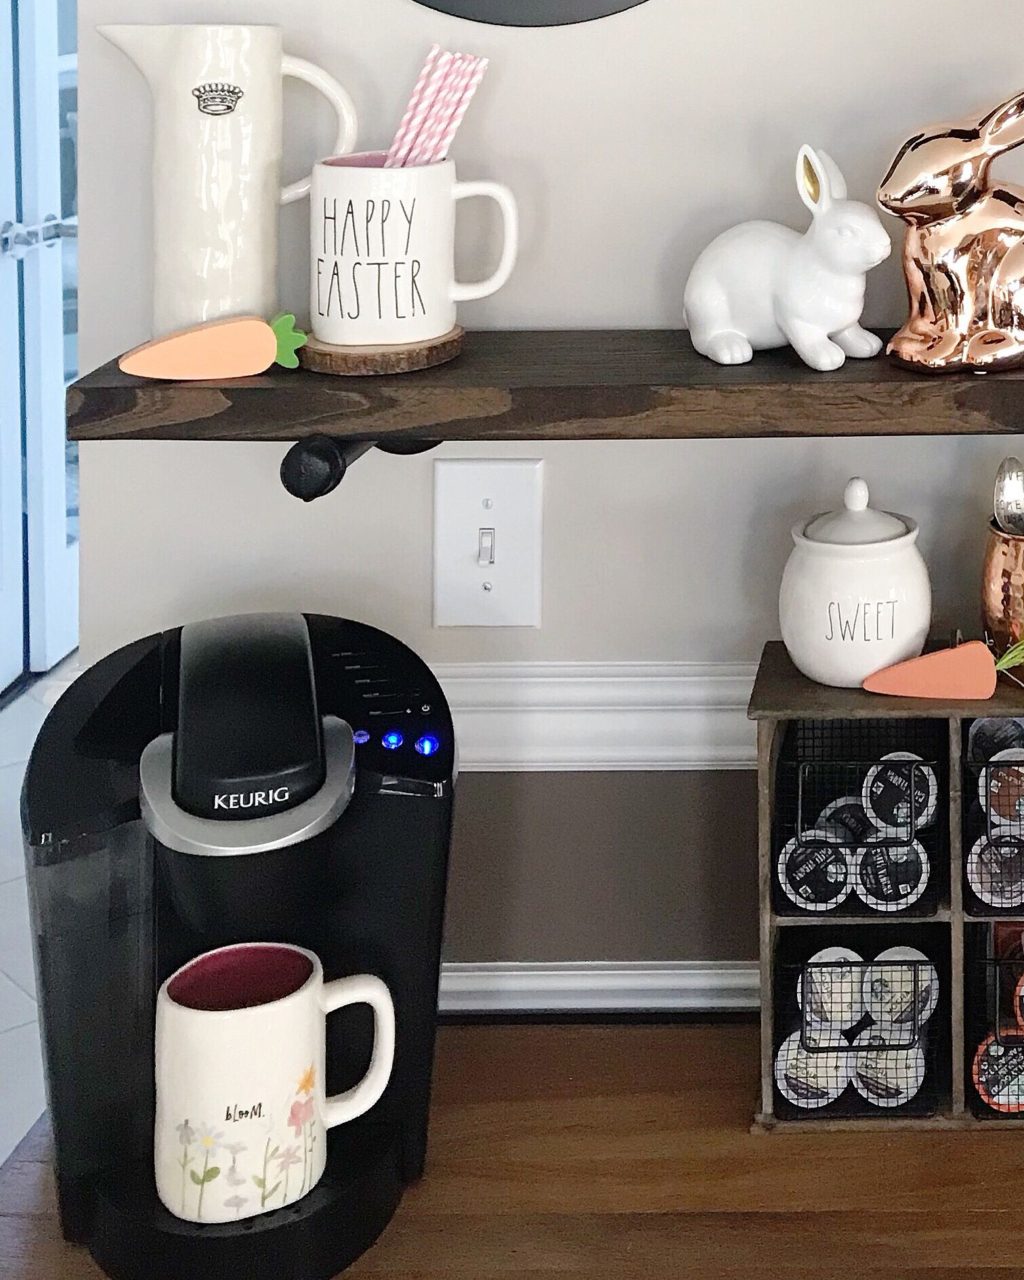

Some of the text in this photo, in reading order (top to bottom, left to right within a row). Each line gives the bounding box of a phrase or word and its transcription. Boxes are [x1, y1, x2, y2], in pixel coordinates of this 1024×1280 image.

[323, 197, 416, 257] HAPPY
[317, 258, 426, 320] EASTER
[825, 600, 898, 642] SWEET
[213, 786, 290, 811] KEURIG
